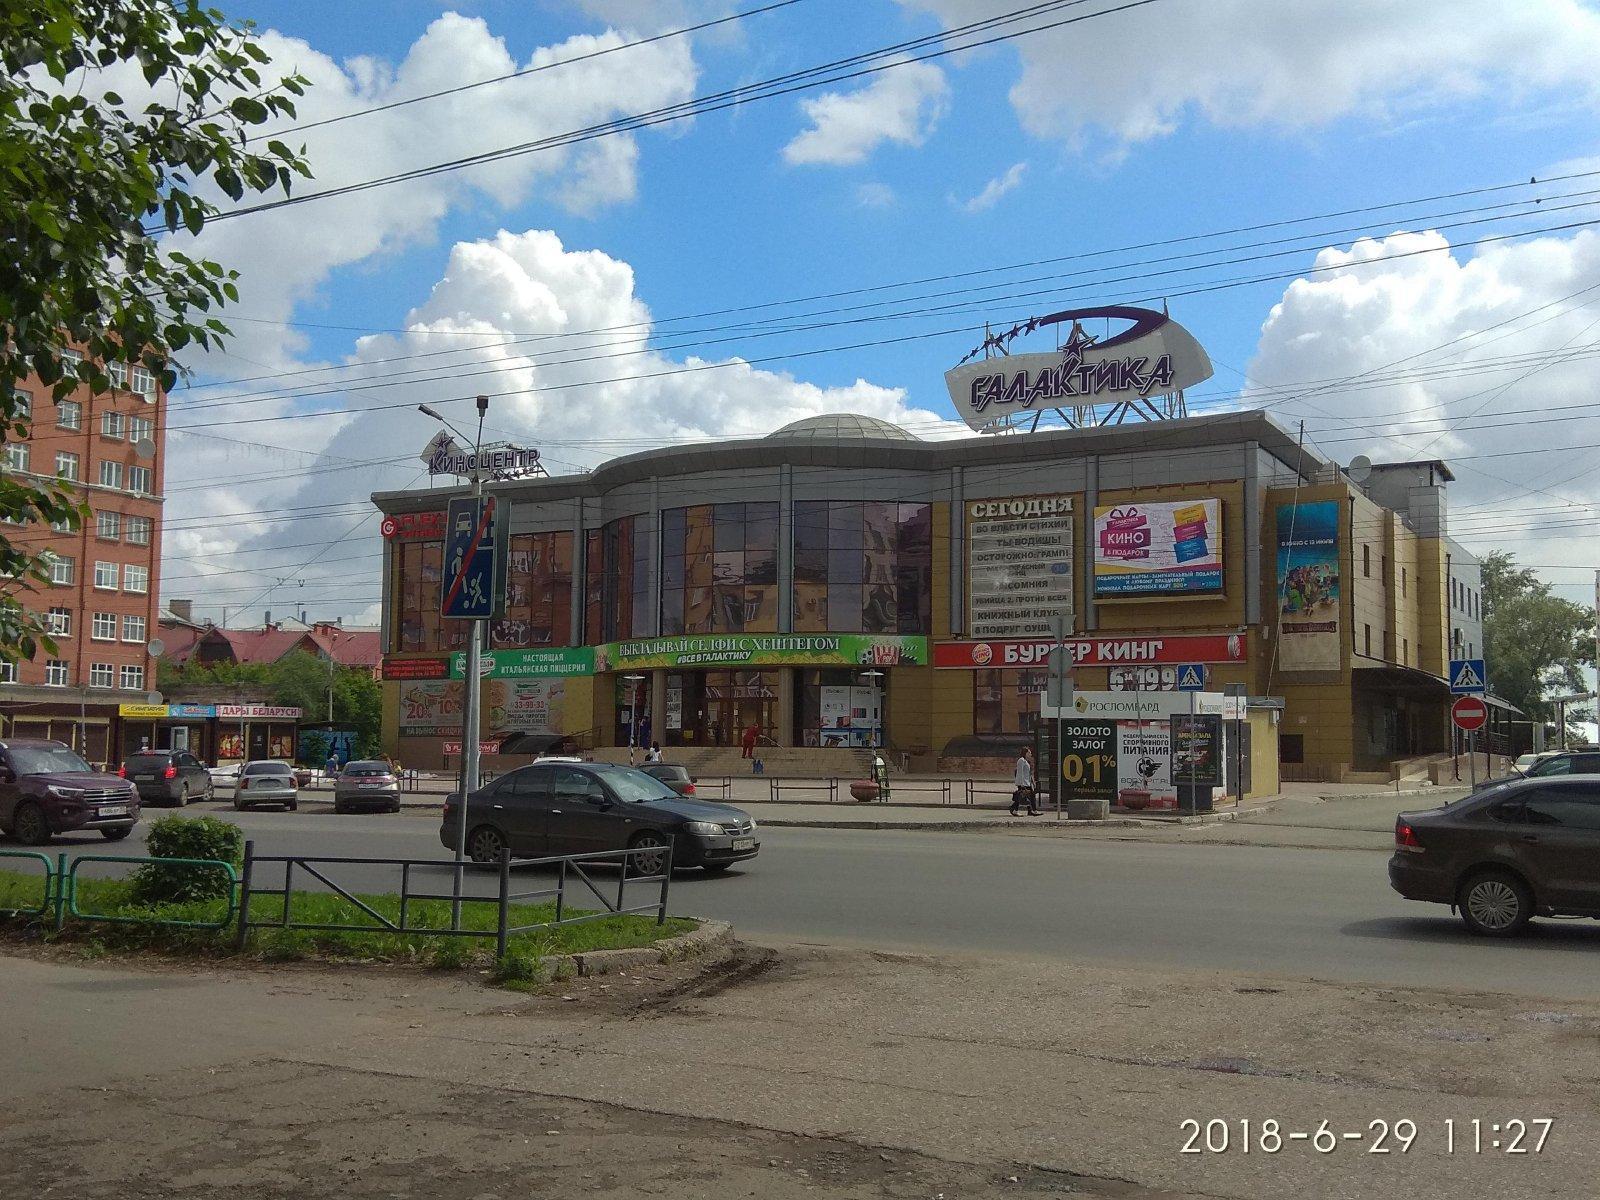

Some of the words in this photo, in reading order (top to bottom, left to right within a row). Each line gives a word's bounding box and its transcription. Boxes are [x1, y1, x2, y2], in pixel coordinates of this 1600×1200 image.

[969, 354, 1175, 412] ГАЛАКТИКА
[429, 449, 540, 475] КИНОЦЕНТР
[971, 497, 1073, 517] СЕГОДНЯ
[976, 525, 988, 533] ВО
[991, 523, 1027, 532] ВЛАСТИ
[1030, 520, 1067, 530] СТИХИИ
[1014, 535, 1061, 546] ВОДИШЬ!
[1107, 532, 1144, 544] КИНО
[977, 610, 1031, 620] КНИЖНЫЙ
[1033, 609, 1060, 617] КЛУБ
[982, 624, 1021, 634] ПОДРУГ
[619, 637, 687, 656] ВЫКЛАДЫВАЙ
[690, 639, 736, 651] СЕЛФИ
[739, 638, 749, 650] С
[752, 638, 839, 650] ХЕШТЕГОМ
[1004, 643, 1091, 662] БУРЕР
[1098, 641, 1163, 660] КИНГ
[523, 653, 564, 662] НАСТОЯЩАЯ
[702, 651, 751, 661] ГАЛАКТИКУ
[501, 664, 548, 673] ИТАЛЬЯНСКАЯ
[549, 663, 586, 672] ПИЦЦЕРИЯ
[1137, 667, 1175, 691] 199
[222, 707, 249, 716] ДАРЫ
[252, 707, 297, 716] БЕЛАРУСИ
[1089, 702, 1160, 713] РОСЛОМБАРД
[1067, 727, 1111, 736] ЗОЛОТО
[1072, 740, 1106, 749] ЗАЛОГ
[1123, 746, 1169, 755] ПИТАНИЯ
[1063, 754, 1116, 784] 0,1%
